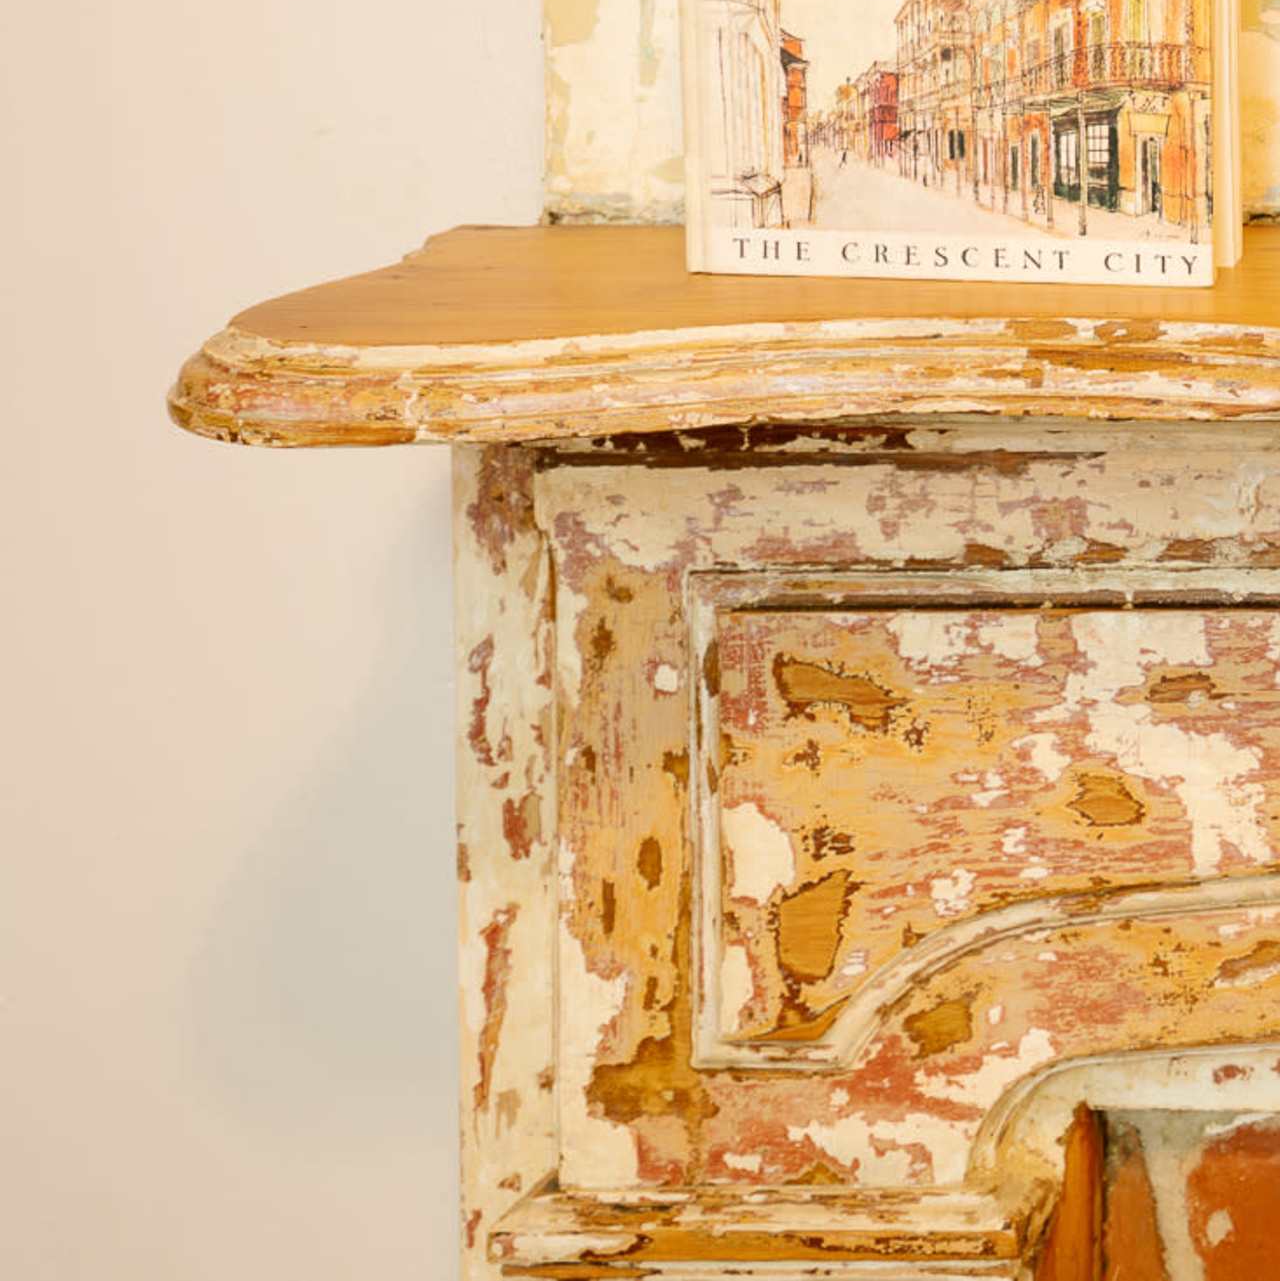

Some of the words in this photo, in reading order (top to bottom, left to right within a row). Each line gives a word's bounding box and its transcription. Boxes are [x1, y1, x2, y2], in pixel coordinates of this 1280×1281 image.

[731, 237, 811, 263] THE
[841, 240, 1071, 271] CRESCENT
[1103, 251, 1199, 275] CITY
